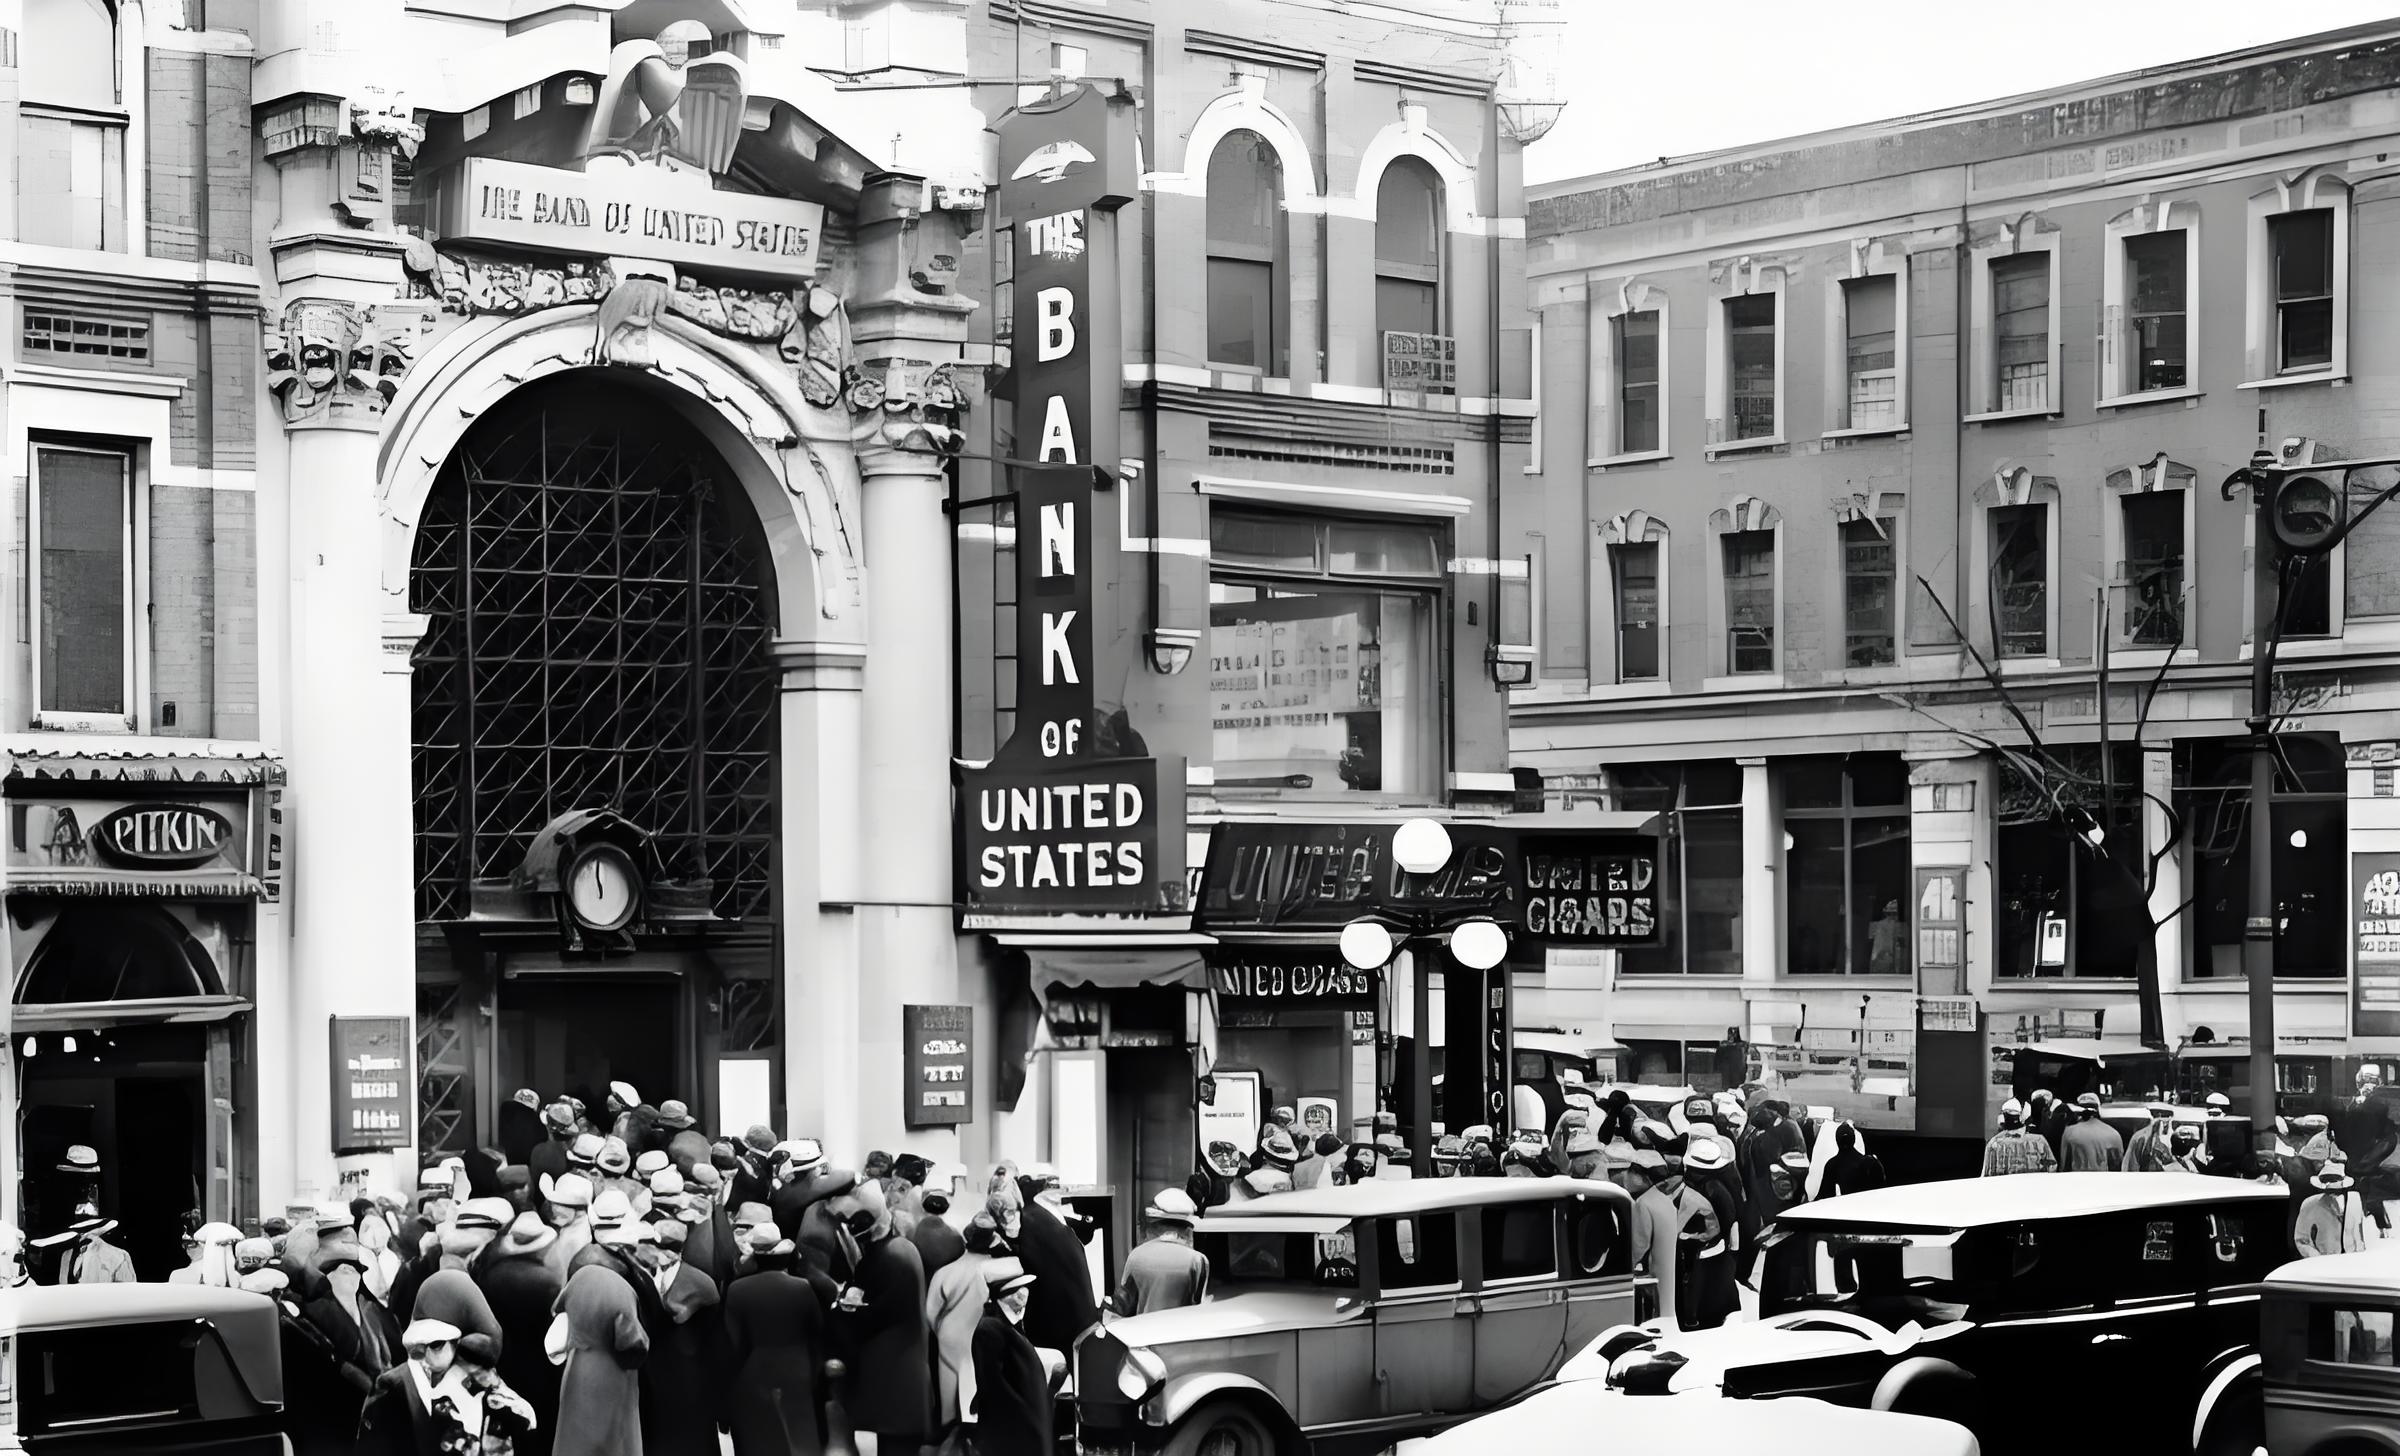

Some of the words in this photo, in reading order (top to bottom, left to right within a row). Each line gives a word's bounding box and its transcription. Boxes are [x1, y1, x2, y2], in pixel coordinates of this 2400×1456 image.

[1025, 209, 1085, 257] THE
[1037, 286, 1081, 685] BANK
[1040, 718, 1082, 757] OF
[980, 783, 1144, 832] UNITED
[114, 810, 217, 852] PITKIN
[980, 842, 1144, 888] STATES
[1526, 896, 1655, 936] CIGARS
